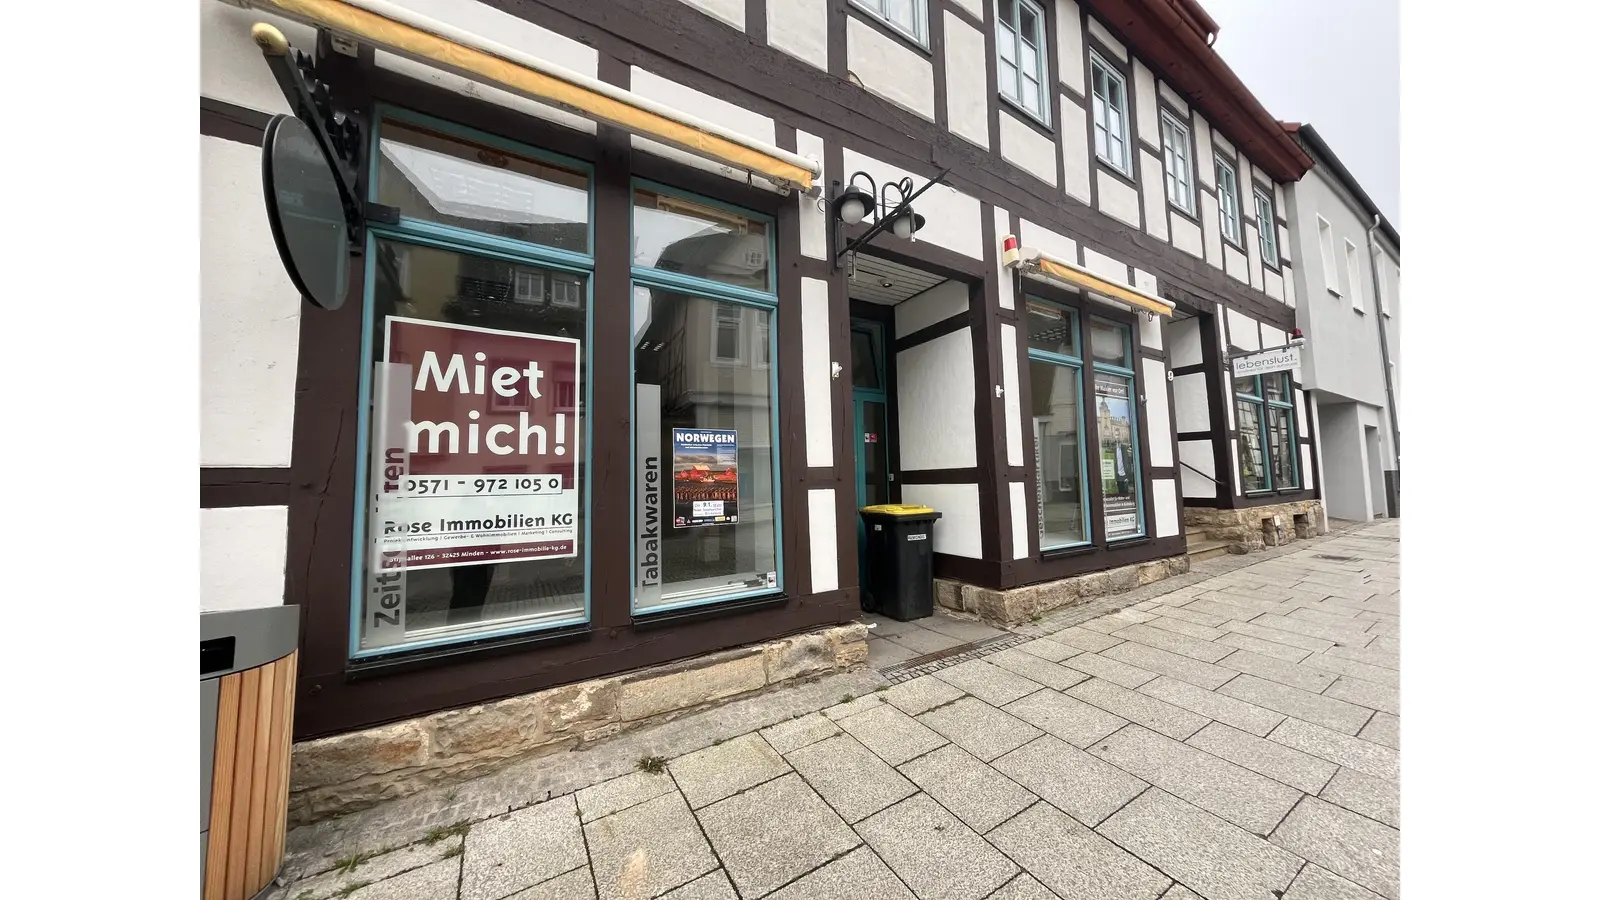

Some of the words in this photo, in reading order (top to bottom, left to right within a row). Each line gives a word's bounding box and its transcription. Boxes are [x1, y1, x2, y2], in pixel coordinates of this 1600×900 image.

[1236, 354, 1297, 370] lebenslust.
[414, 350, 544, 399] Miet
[1167, 370, 1174, 381] 9
[404, 410, 566, 456] mich!
[676, 433, 735, 443] NORWEGEN
[474, 478, 508, 493] 972
[515, 478, 542, 491] 105
[548, 478, 559, 489] 0
[440, 513, 545, 532] Immobilien
[551, 512, 573, 526] KG
[641, 456, 658, 591] Tabakwaren
[460, 549, 485, 557] Minden
